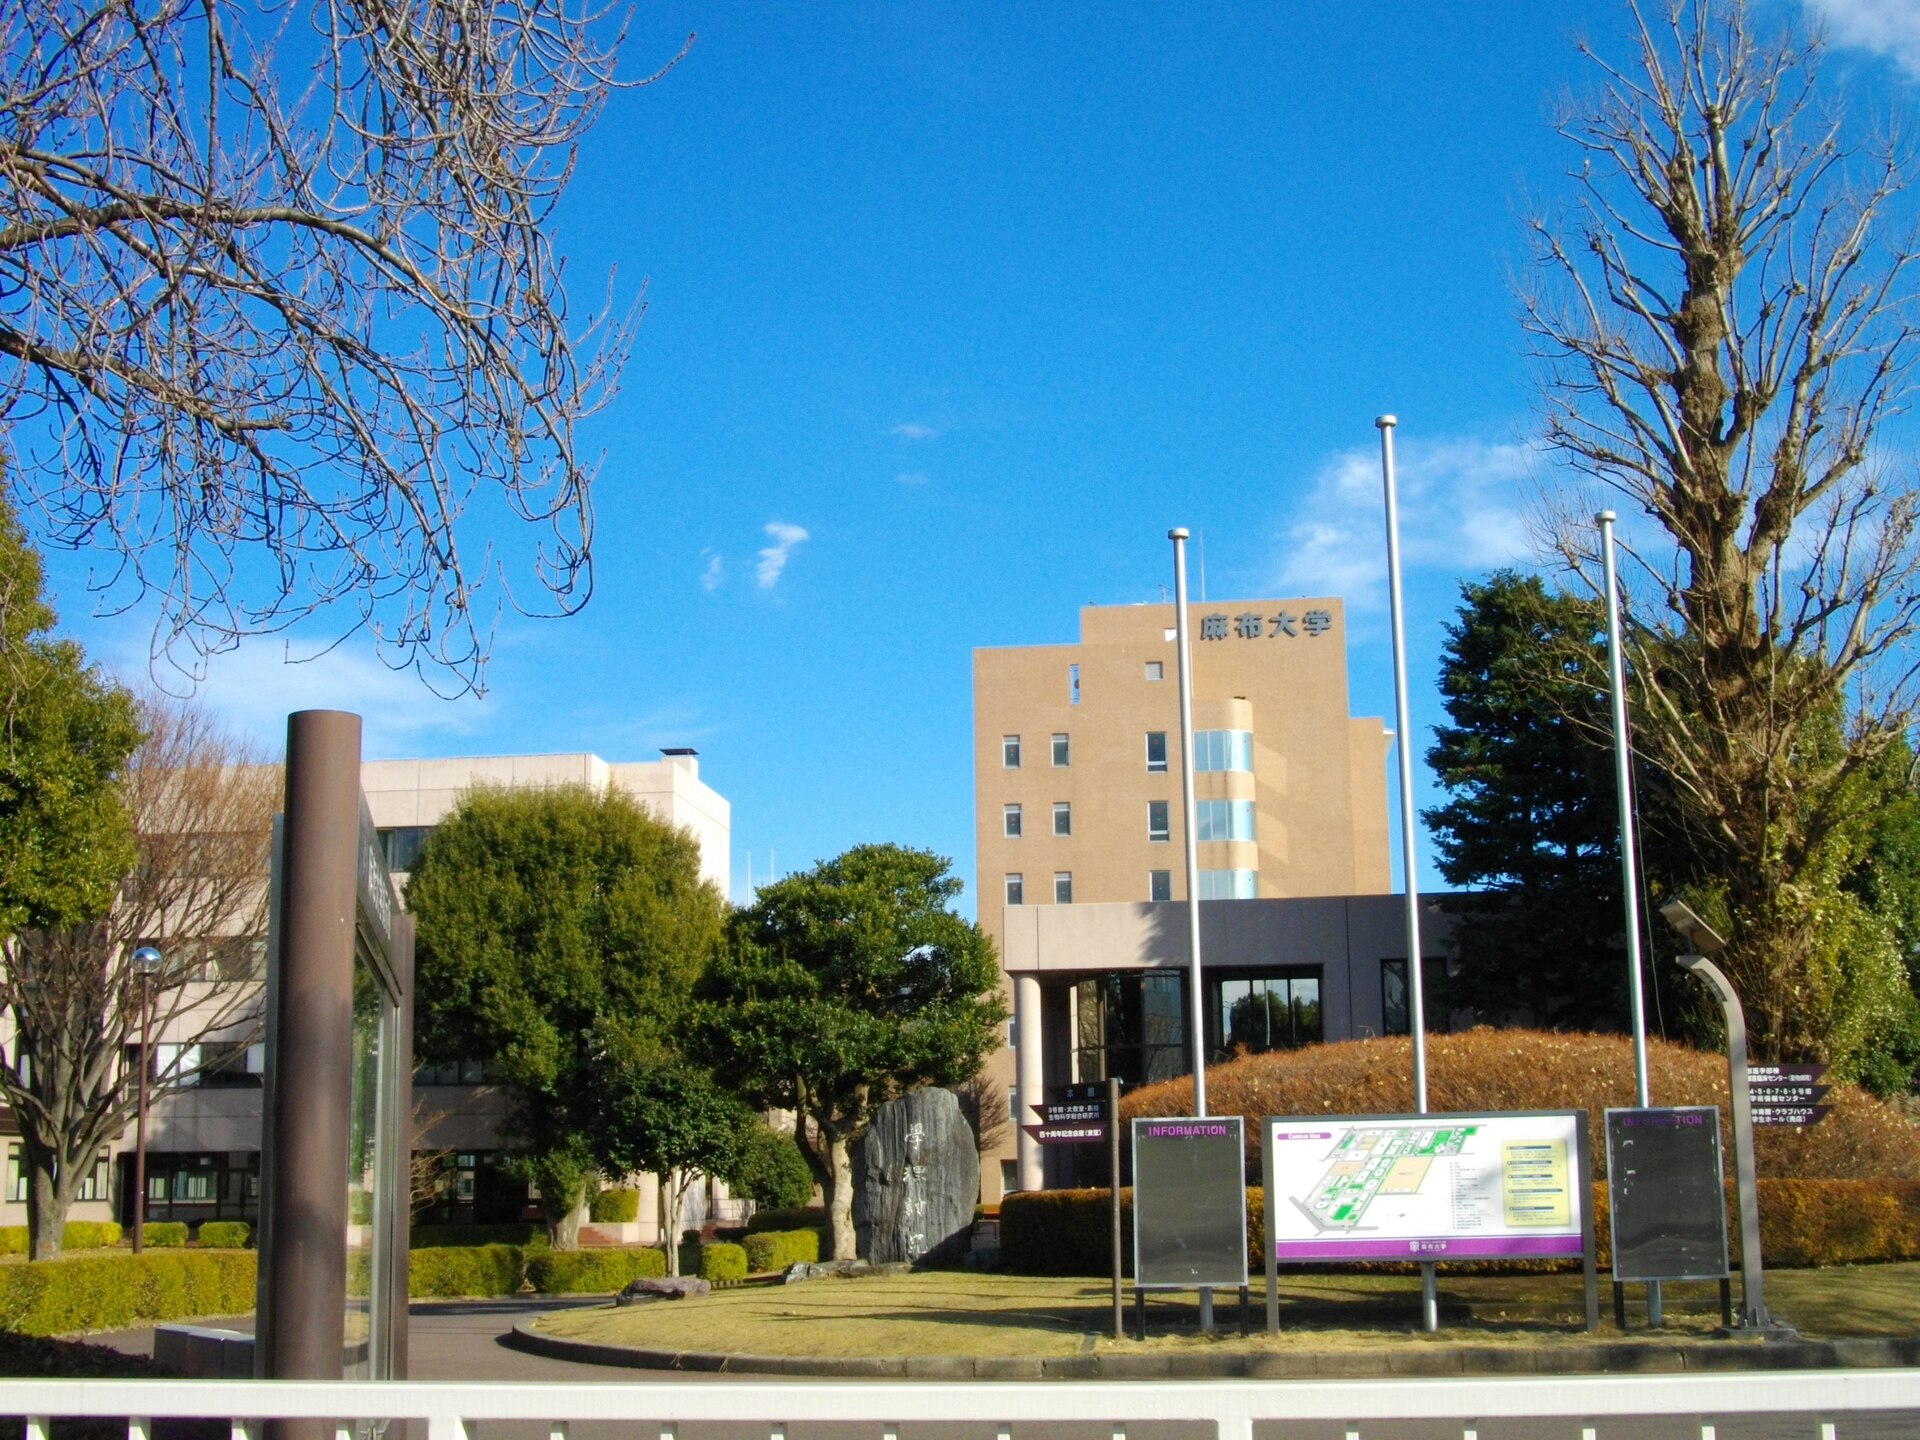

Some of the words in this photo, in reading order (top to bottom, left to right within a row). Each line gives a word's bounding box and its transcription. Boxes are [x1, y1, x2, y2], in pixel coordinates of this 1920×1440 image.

[1200, 609, 1332, 641] 麻布大学
[1048, 1112, 1100, 1121] 生物科学総合研究所
[1148, 1125, 1227, 1136] INFORMATION
